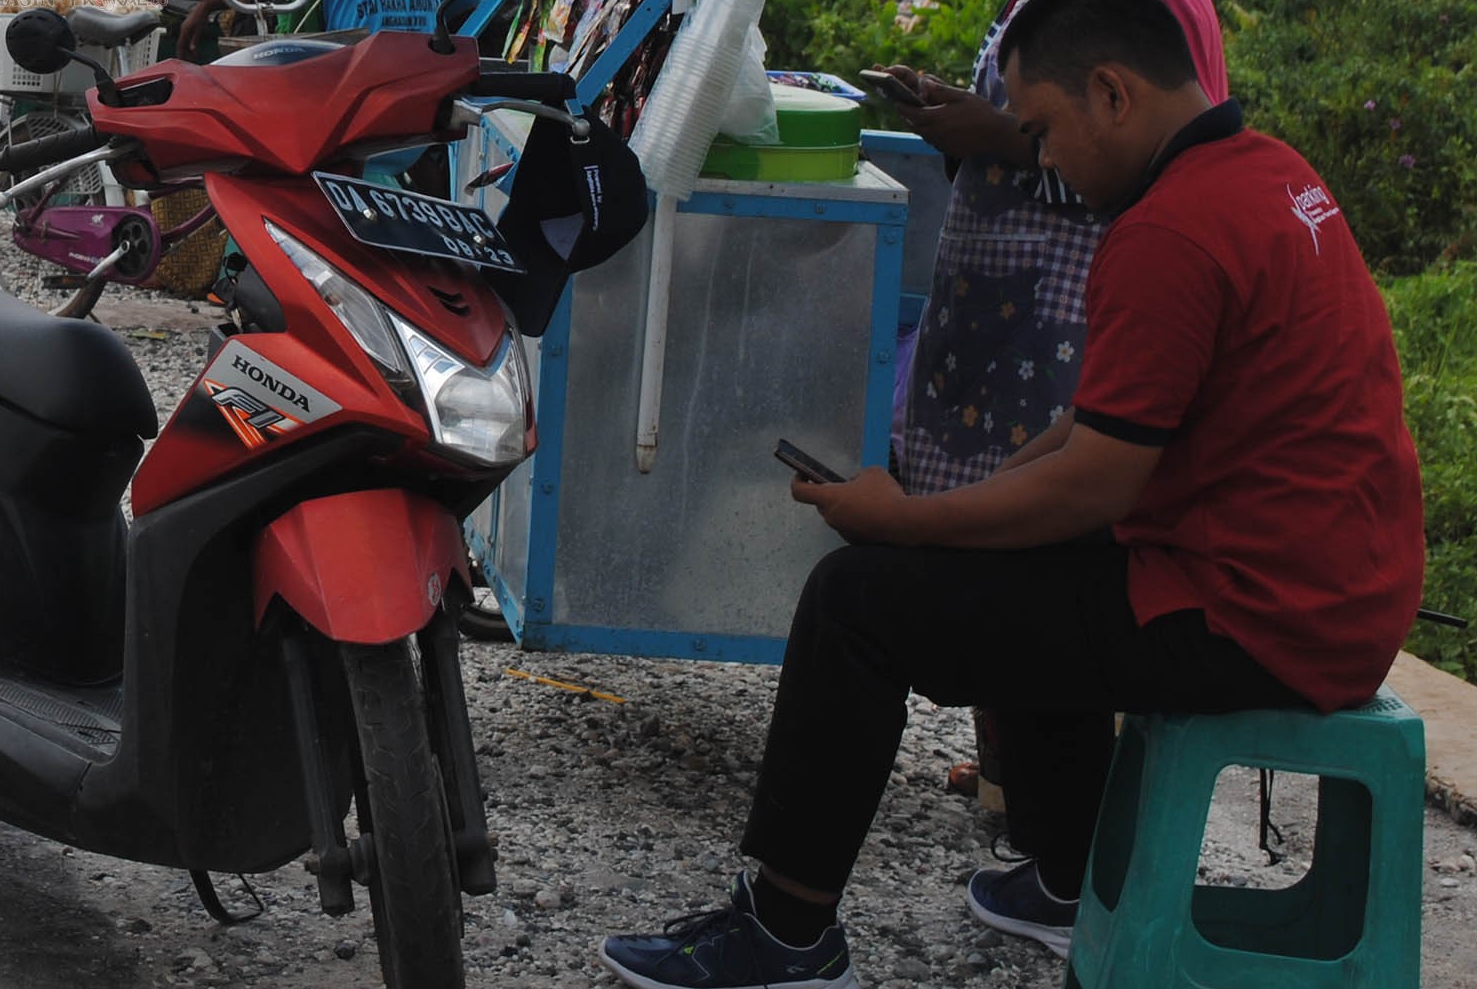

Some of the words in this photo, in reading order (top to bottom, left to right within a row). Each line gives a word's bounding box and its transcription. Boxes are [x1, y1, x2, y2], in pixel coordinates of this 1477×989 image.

[326, 180, 370, 216] DA
[369, 189, 444, 228] 6739
[435, 205, 495, 239] BAC
[231, 354, 310, 413] HONDA
